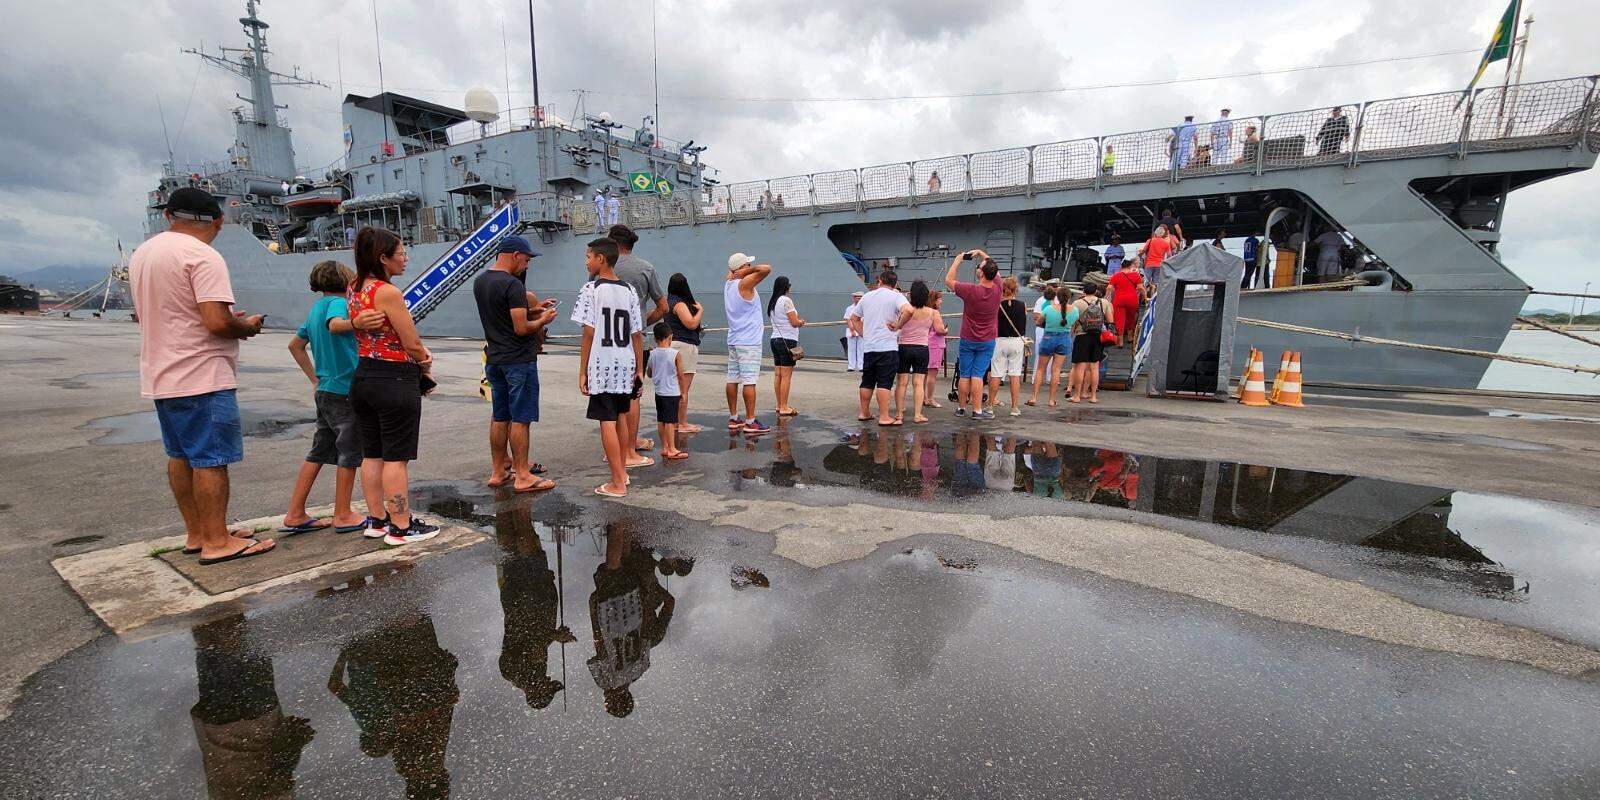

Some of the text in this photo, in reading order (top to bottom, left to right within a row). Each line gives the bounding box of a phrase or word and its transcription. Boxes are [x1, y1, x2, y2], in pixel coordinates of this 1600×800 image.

[414, 236, 485, 297] NE BRASIL
[601, 307, 630, 347] 10
